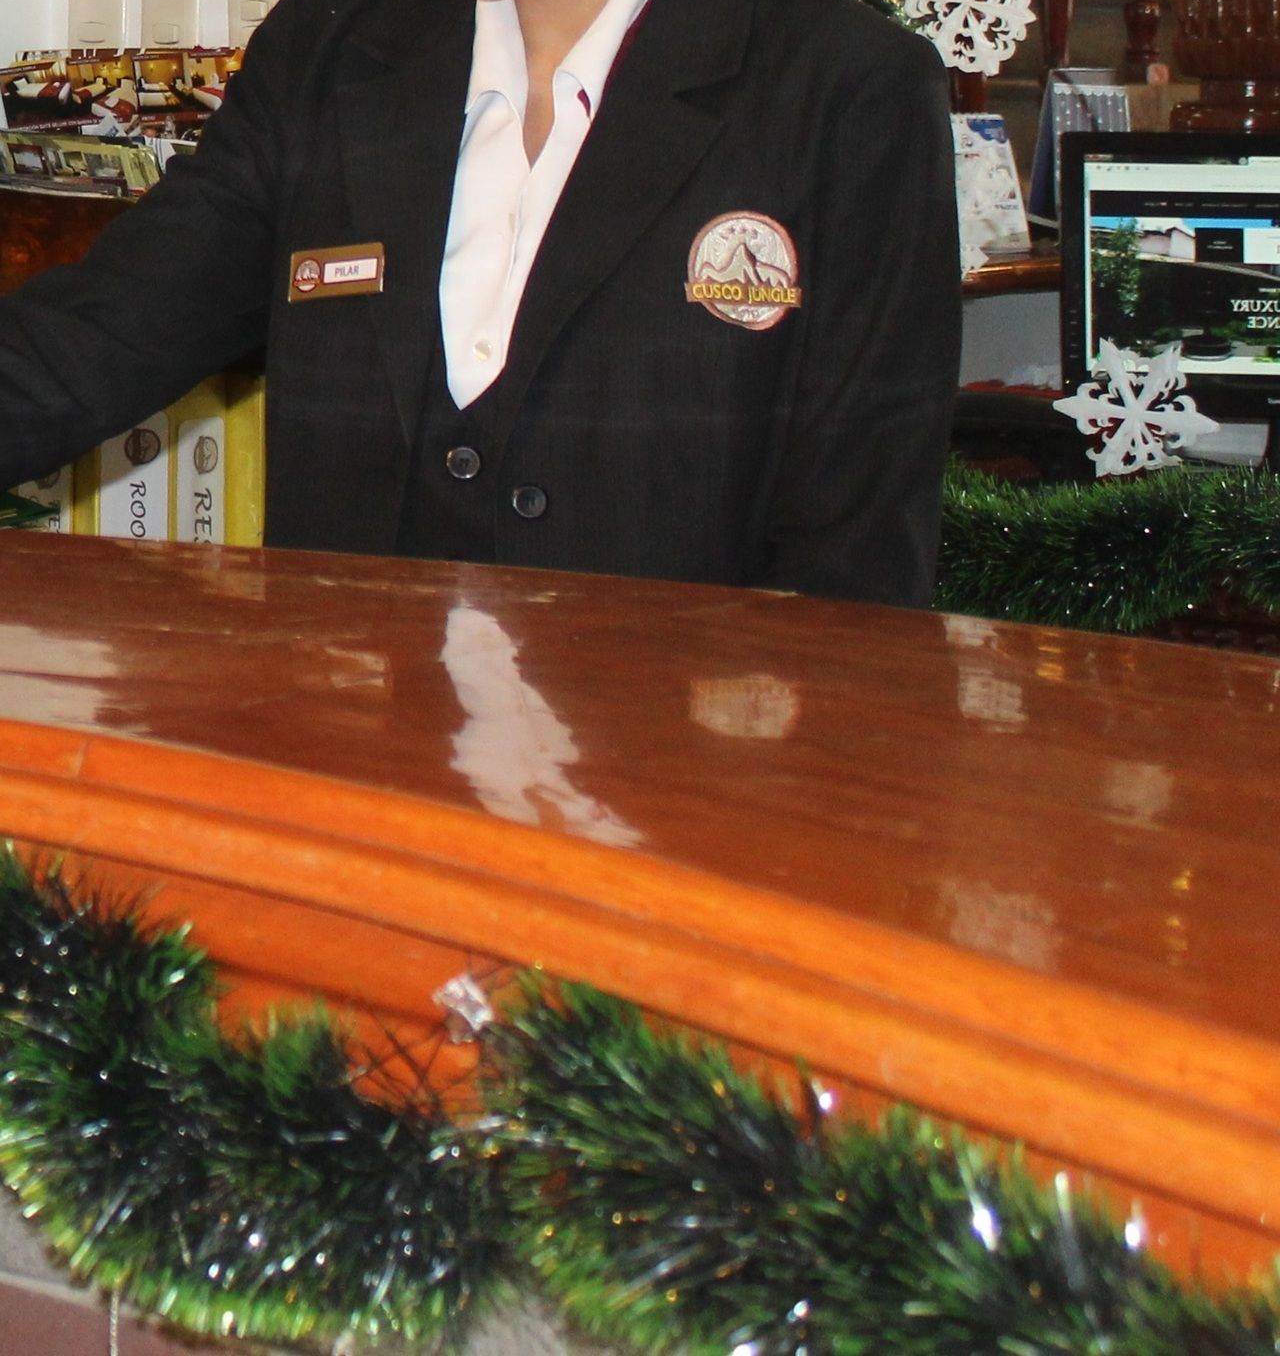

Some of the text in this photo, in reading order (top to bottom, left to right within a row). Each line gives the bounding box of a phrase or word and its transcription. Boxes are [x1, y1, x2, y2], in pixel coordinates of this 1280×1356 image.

[334, 265, 360, 277] PILAR
[692, 284, 797, 304] CUSCO JUNGLE
